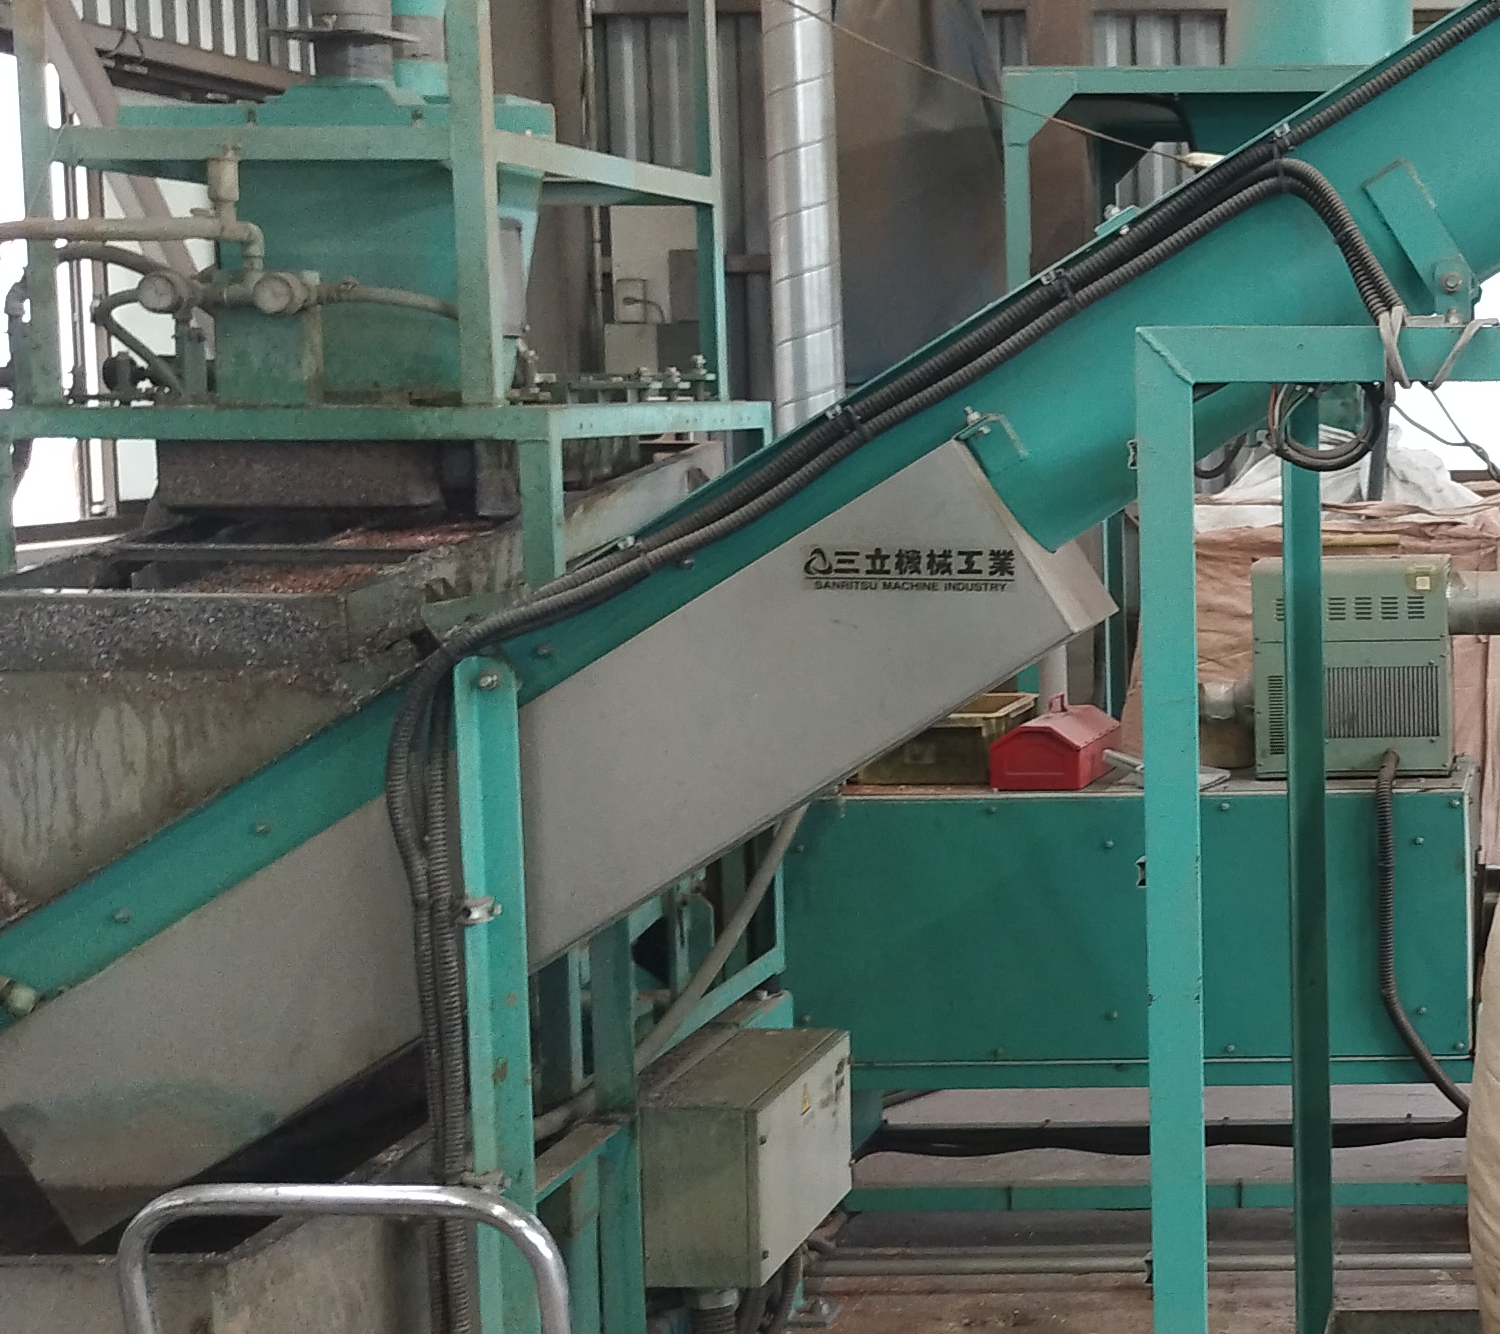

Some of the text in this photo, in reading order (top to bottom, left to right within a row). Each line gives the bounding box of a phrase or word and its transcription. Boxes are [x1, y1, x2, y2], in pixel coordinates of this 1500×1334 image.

[833, 547, 1015, 576] 三立機械工業
[814, 580, 1008, 592] SANRITSU MACHINE INDUSTRY
